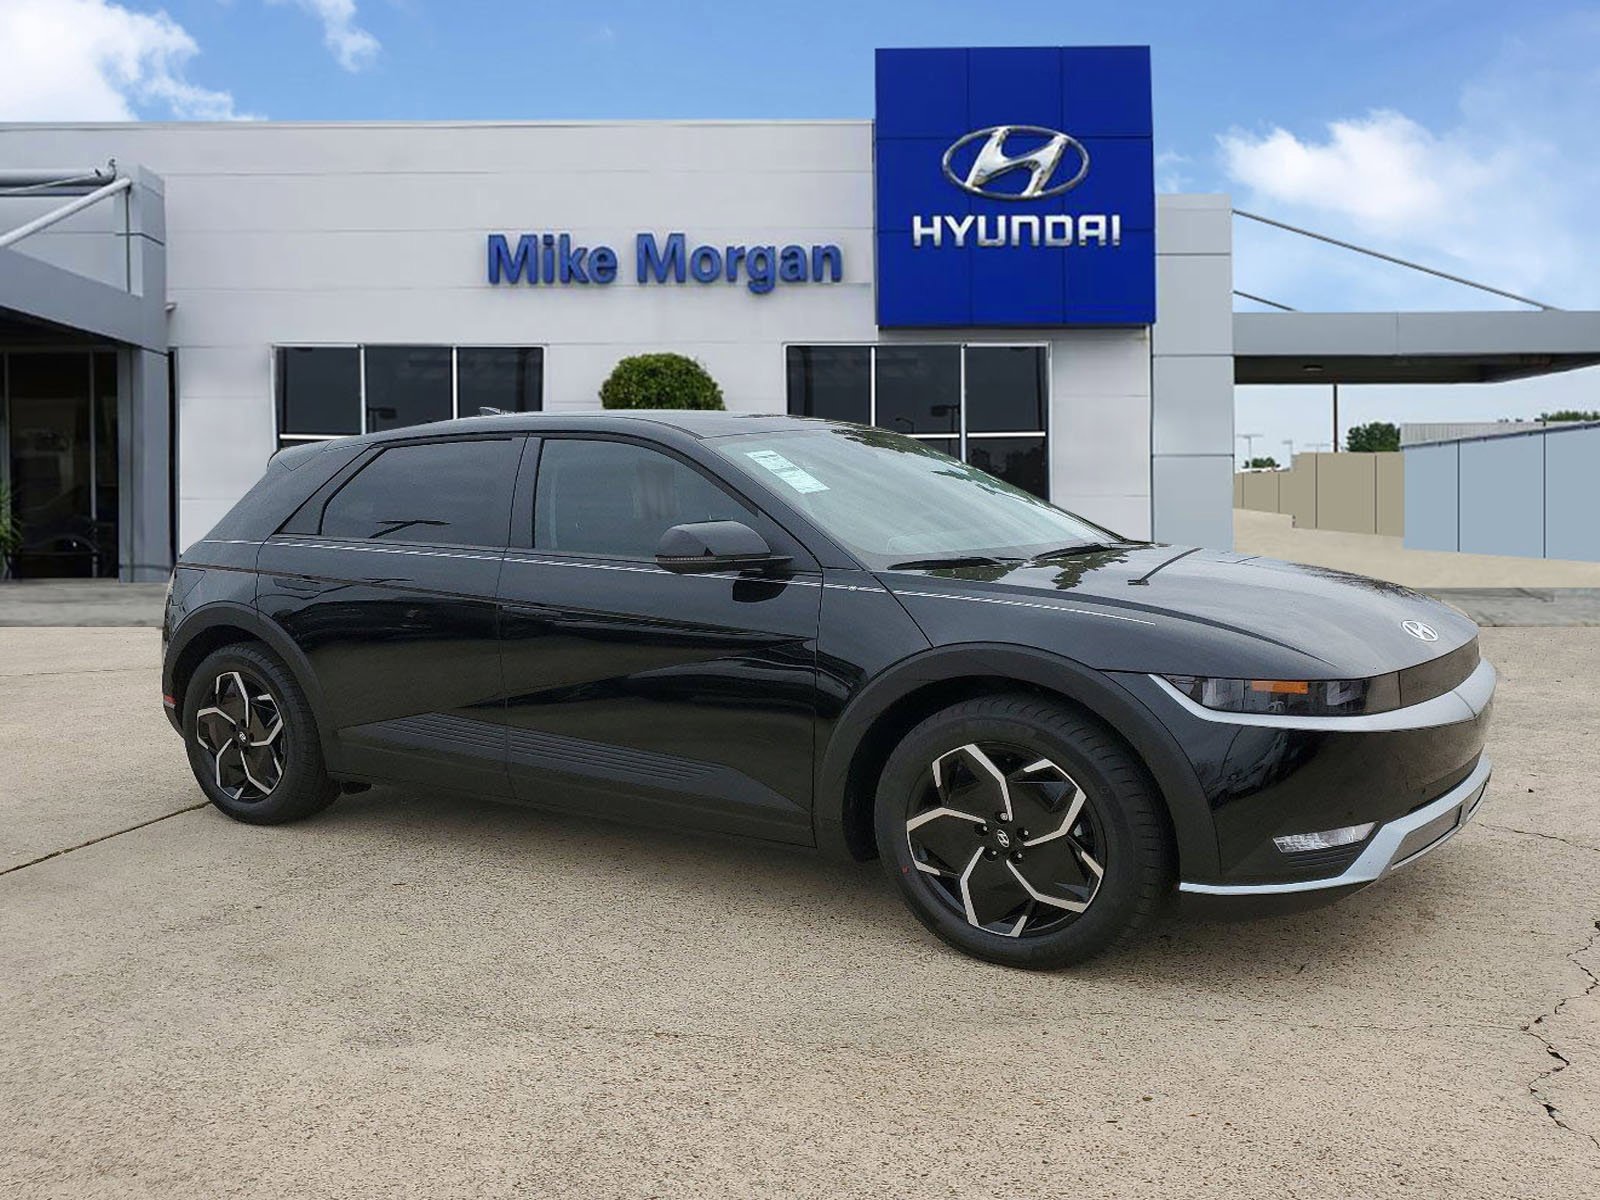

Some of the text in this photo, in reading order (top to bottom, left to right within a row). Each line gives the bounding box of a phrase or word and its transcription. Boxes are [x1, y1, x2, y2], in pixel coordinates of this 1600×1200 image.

[912, 214, 1121, 247] HYUNDAI
[487, 232, 842, 295] Mike Morgan
